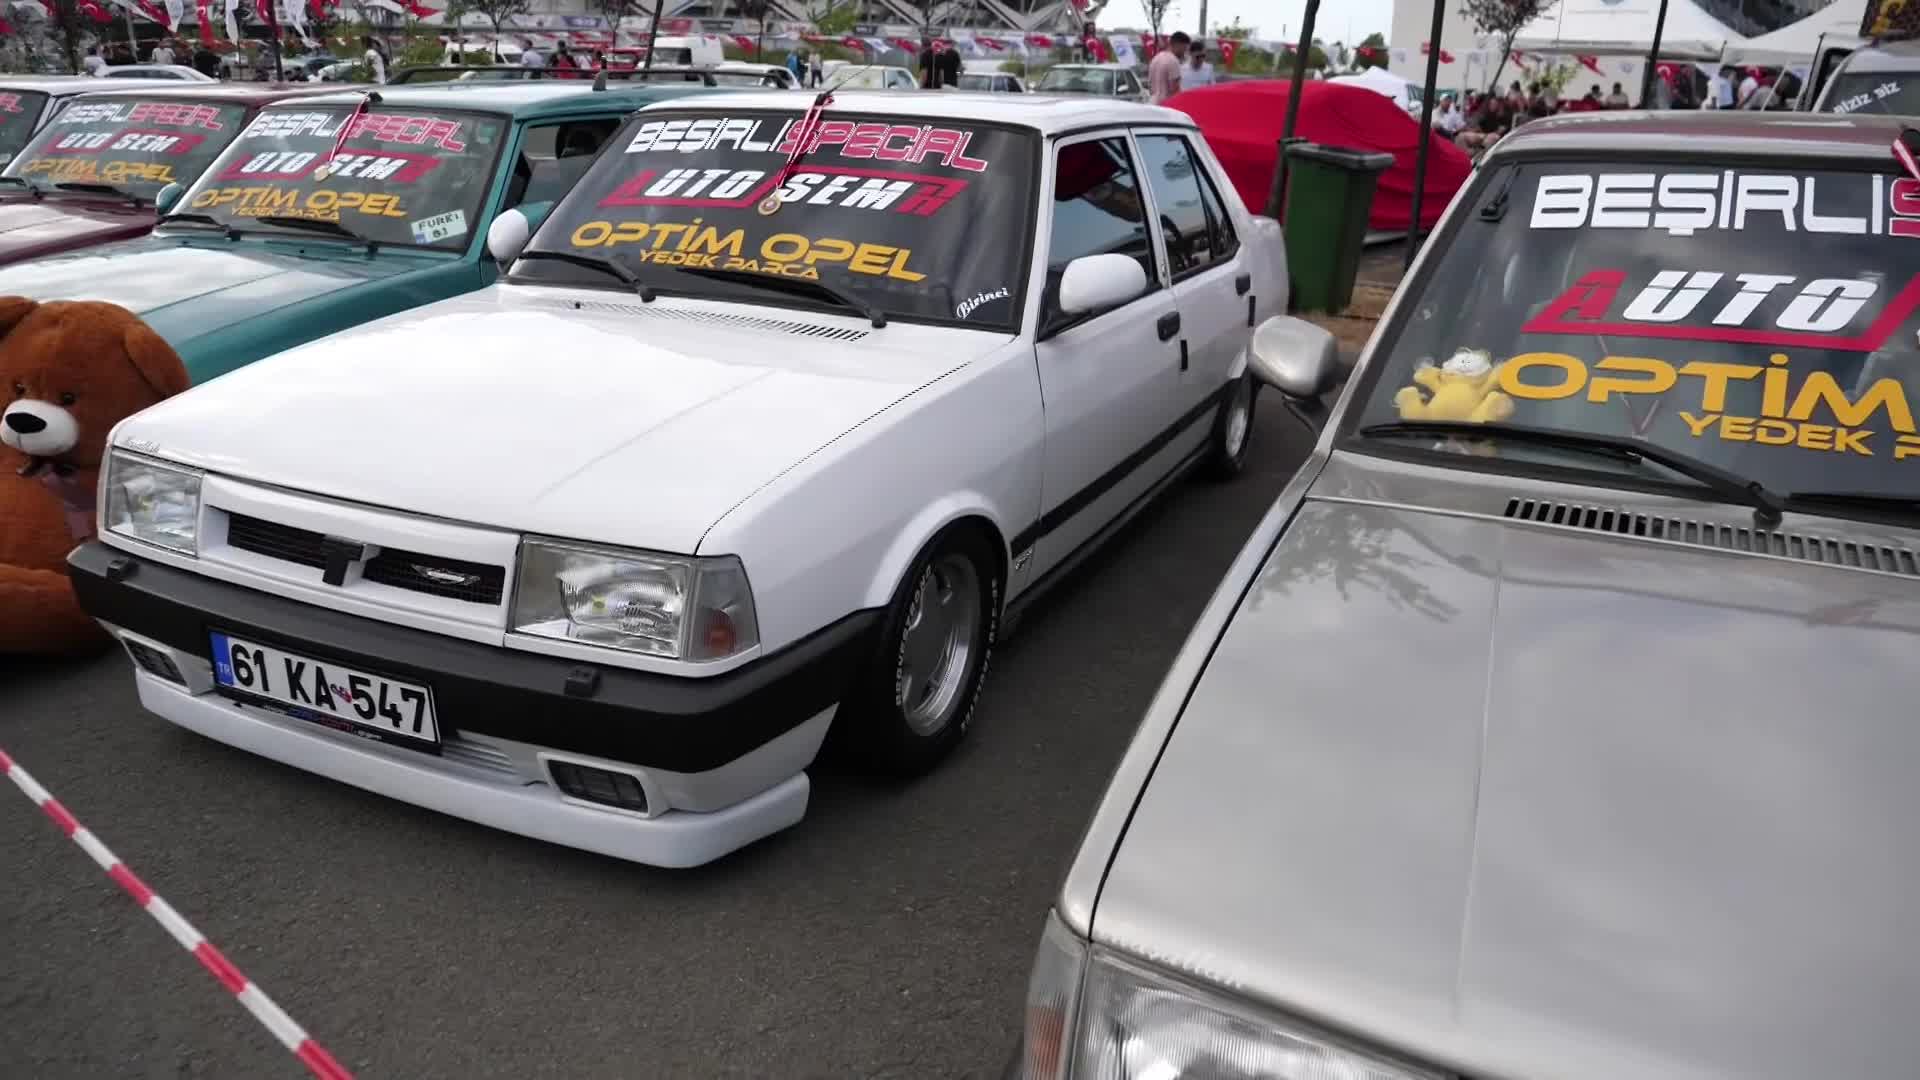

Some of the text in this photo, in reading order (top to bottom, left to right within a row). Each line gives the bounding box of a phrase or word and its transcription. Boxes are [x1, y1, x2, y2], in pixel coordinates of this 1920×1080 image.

[306, 190, 408, 217] OPEL
[639, 248, 721, 268] YEDEK
[760, 232, 928, 282] OPEL
[1530, 268, 1881, 333] AUTO
[1499, 353, 1919, 434] OPTİM
[1680, 411, 1876, 456] YEDEK
[230, 643, 270, 692] 61
[284, 657, 337, 711] KA
[348, 674, 426, 733] 547
